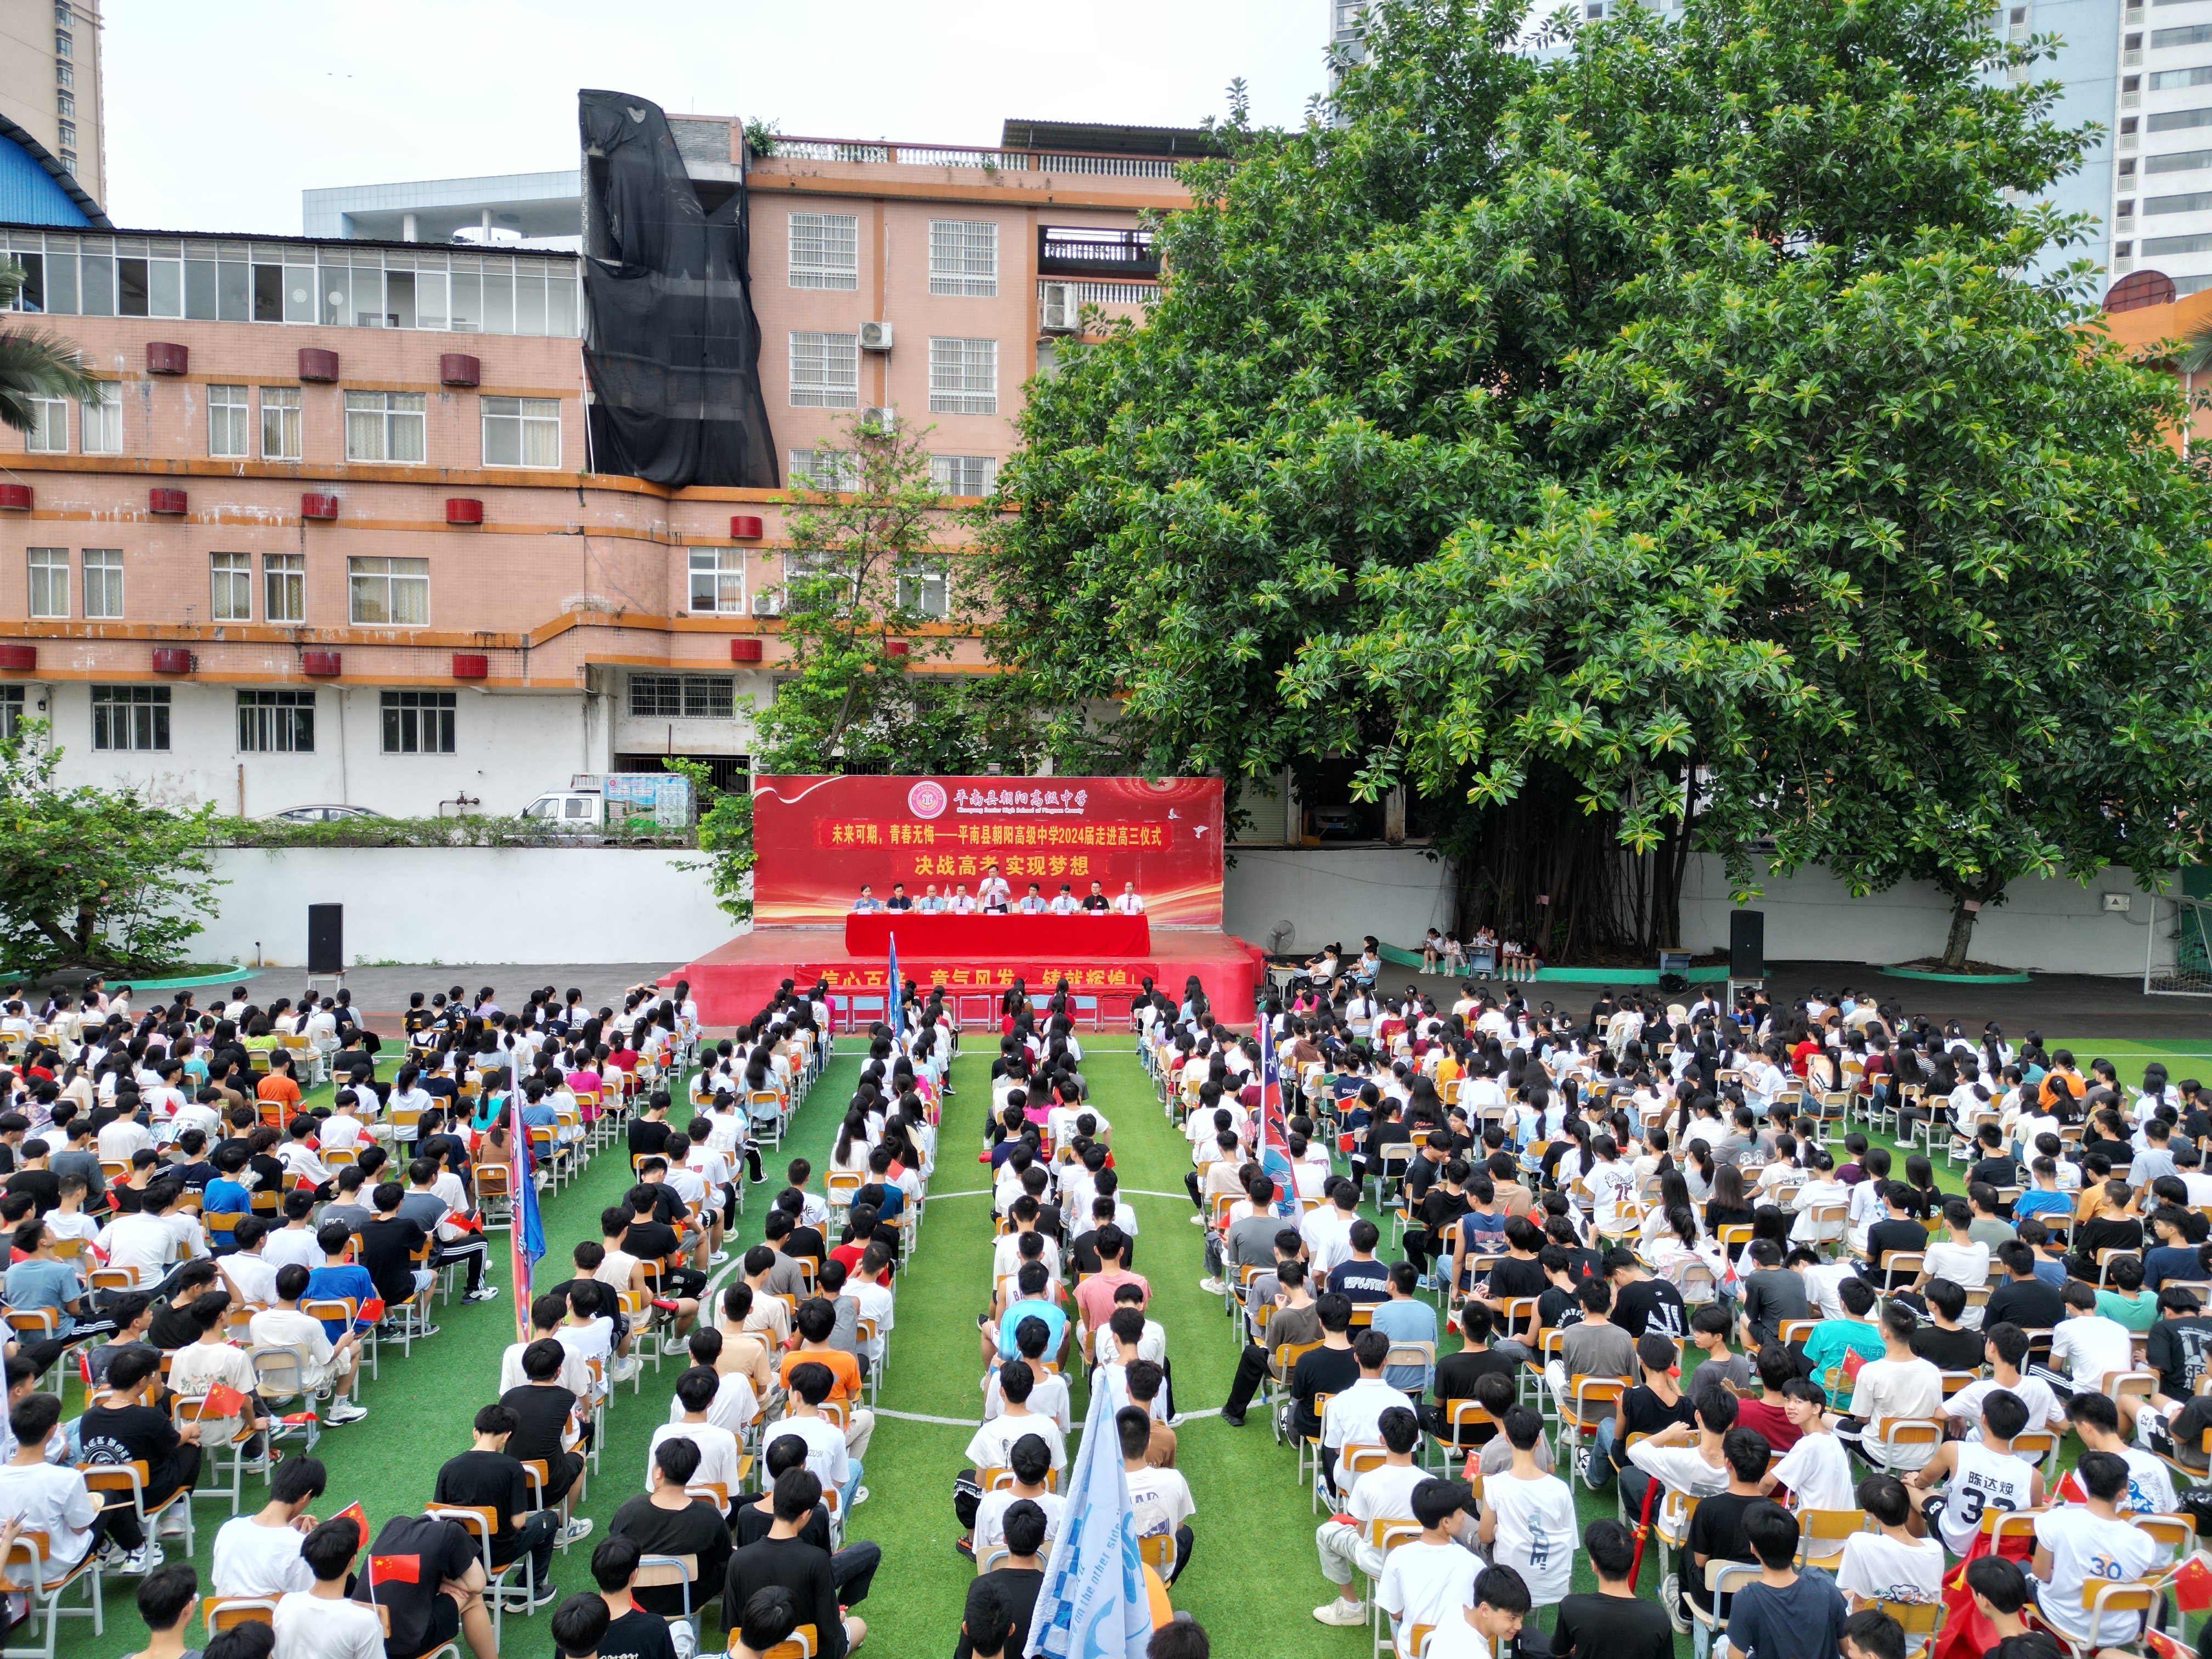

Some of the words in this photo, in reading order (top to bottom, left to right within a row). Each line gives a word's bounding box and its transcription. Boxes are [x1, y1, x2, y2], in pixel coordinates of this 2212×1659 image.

[953, 788, 1088, 806] 平南县朝阳高级中学
[1006, 855, 1089, 877] 实现梦想
[1968, 1471, 2014, 1496] 陈达焕
[2089, 1557, 2122, 1579] 30
[1080, 1584, 1095, 1606] the
